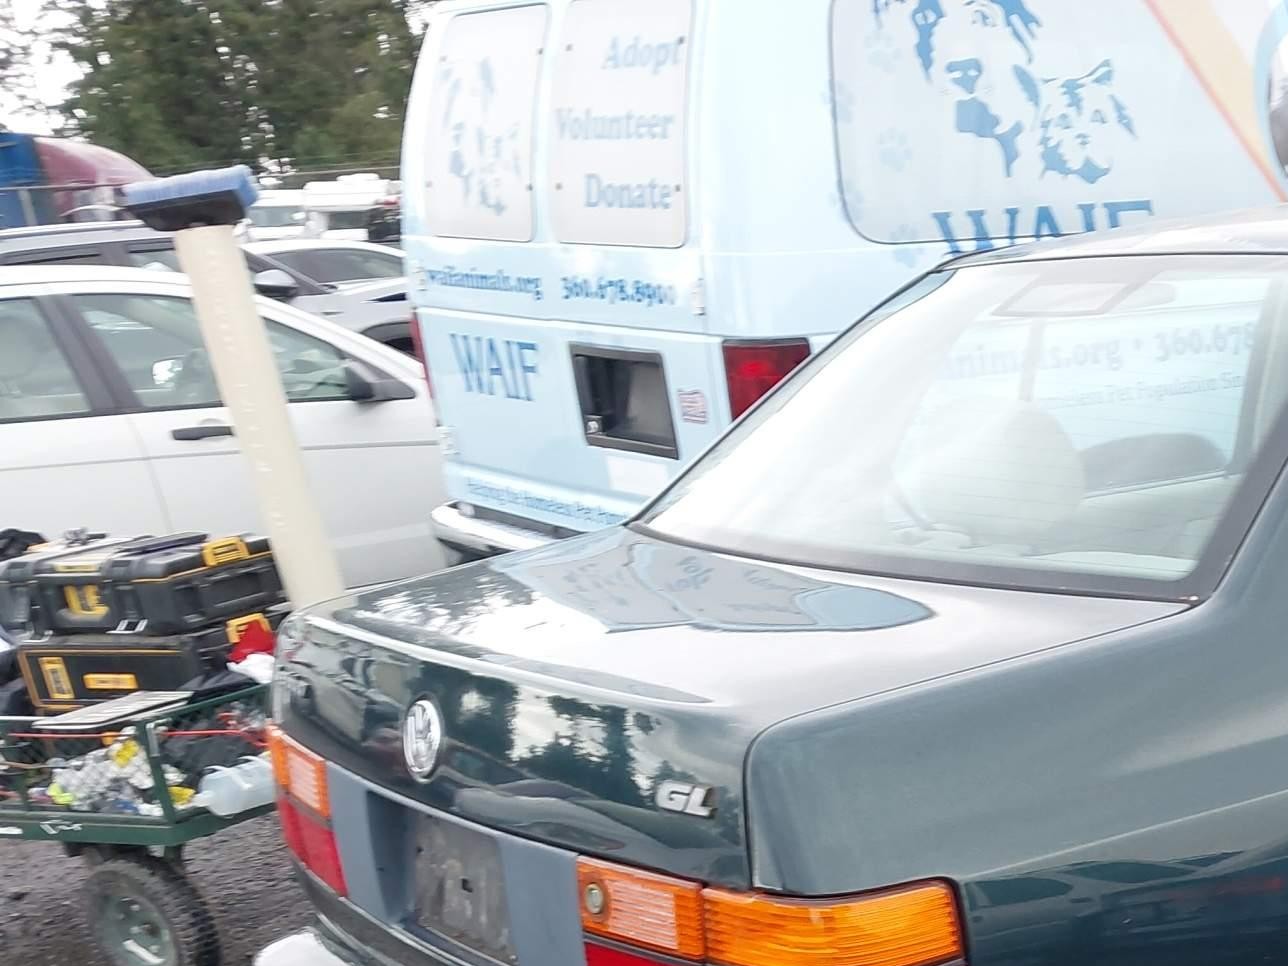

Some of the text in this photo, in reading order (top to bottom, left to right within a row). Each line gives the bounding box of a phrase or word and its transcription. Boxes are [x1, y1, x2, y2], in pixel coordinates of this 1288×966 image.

[600, 35, 681, 75] Adopt
[556, 107, 674, 140] Volunteer
[584, 172, 672, 209] Donate
[449, 333, 538, 401] WAIF
[655, 780, 716, 818] GL
